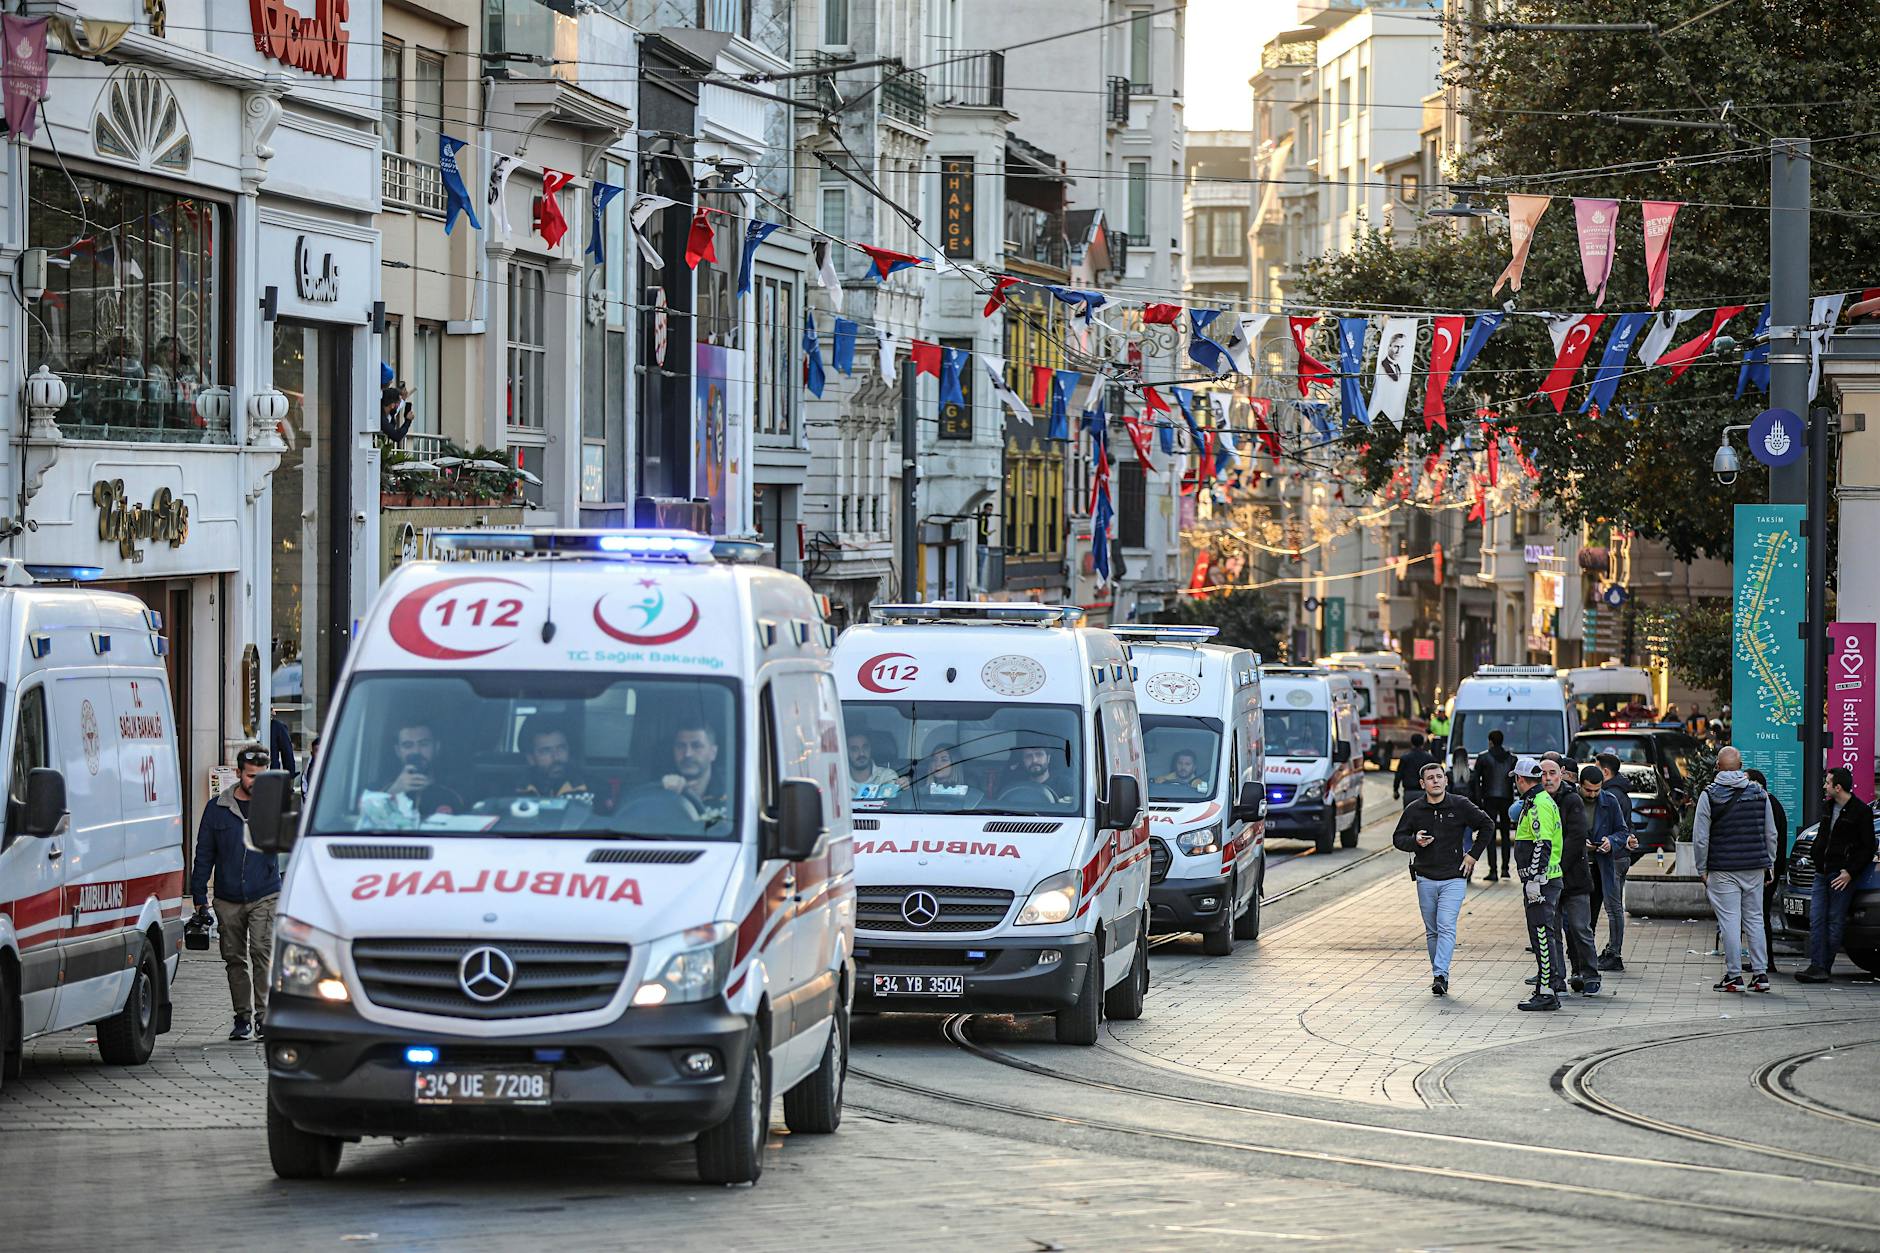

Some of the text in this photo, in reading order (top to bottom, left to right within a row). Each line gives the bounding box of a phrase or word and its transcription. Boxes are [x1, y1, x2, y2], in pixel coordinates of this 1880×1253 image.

[948, 163, 960, 250] CHANGE
[436, 598, 524, 627] 112
[874, 665, 919, 681] 112
[141, 755, 157, 802] 112
[79, 883, 122, 911] AMBULANS
[882, 976, 961, 993] 34 YB 3504
[425, 1074, 543, 1098] 34 UE 7208
